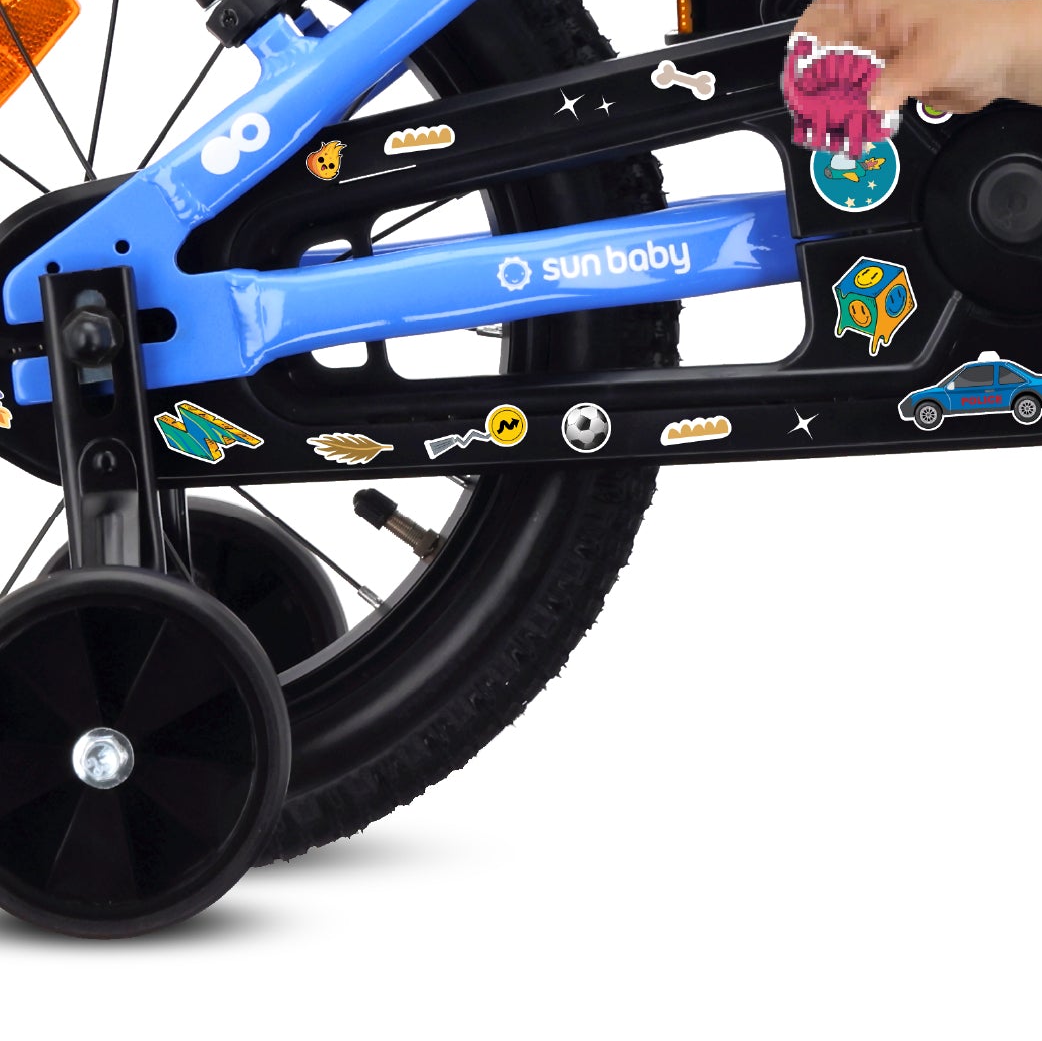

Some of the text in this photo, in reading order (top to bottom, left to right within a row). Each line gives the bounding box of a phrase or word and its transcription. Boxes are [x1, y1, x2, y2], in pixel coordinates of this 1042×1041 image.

[542, 240, 691, 281] sun baby
[961, 395, 1003, 406] POLICE
